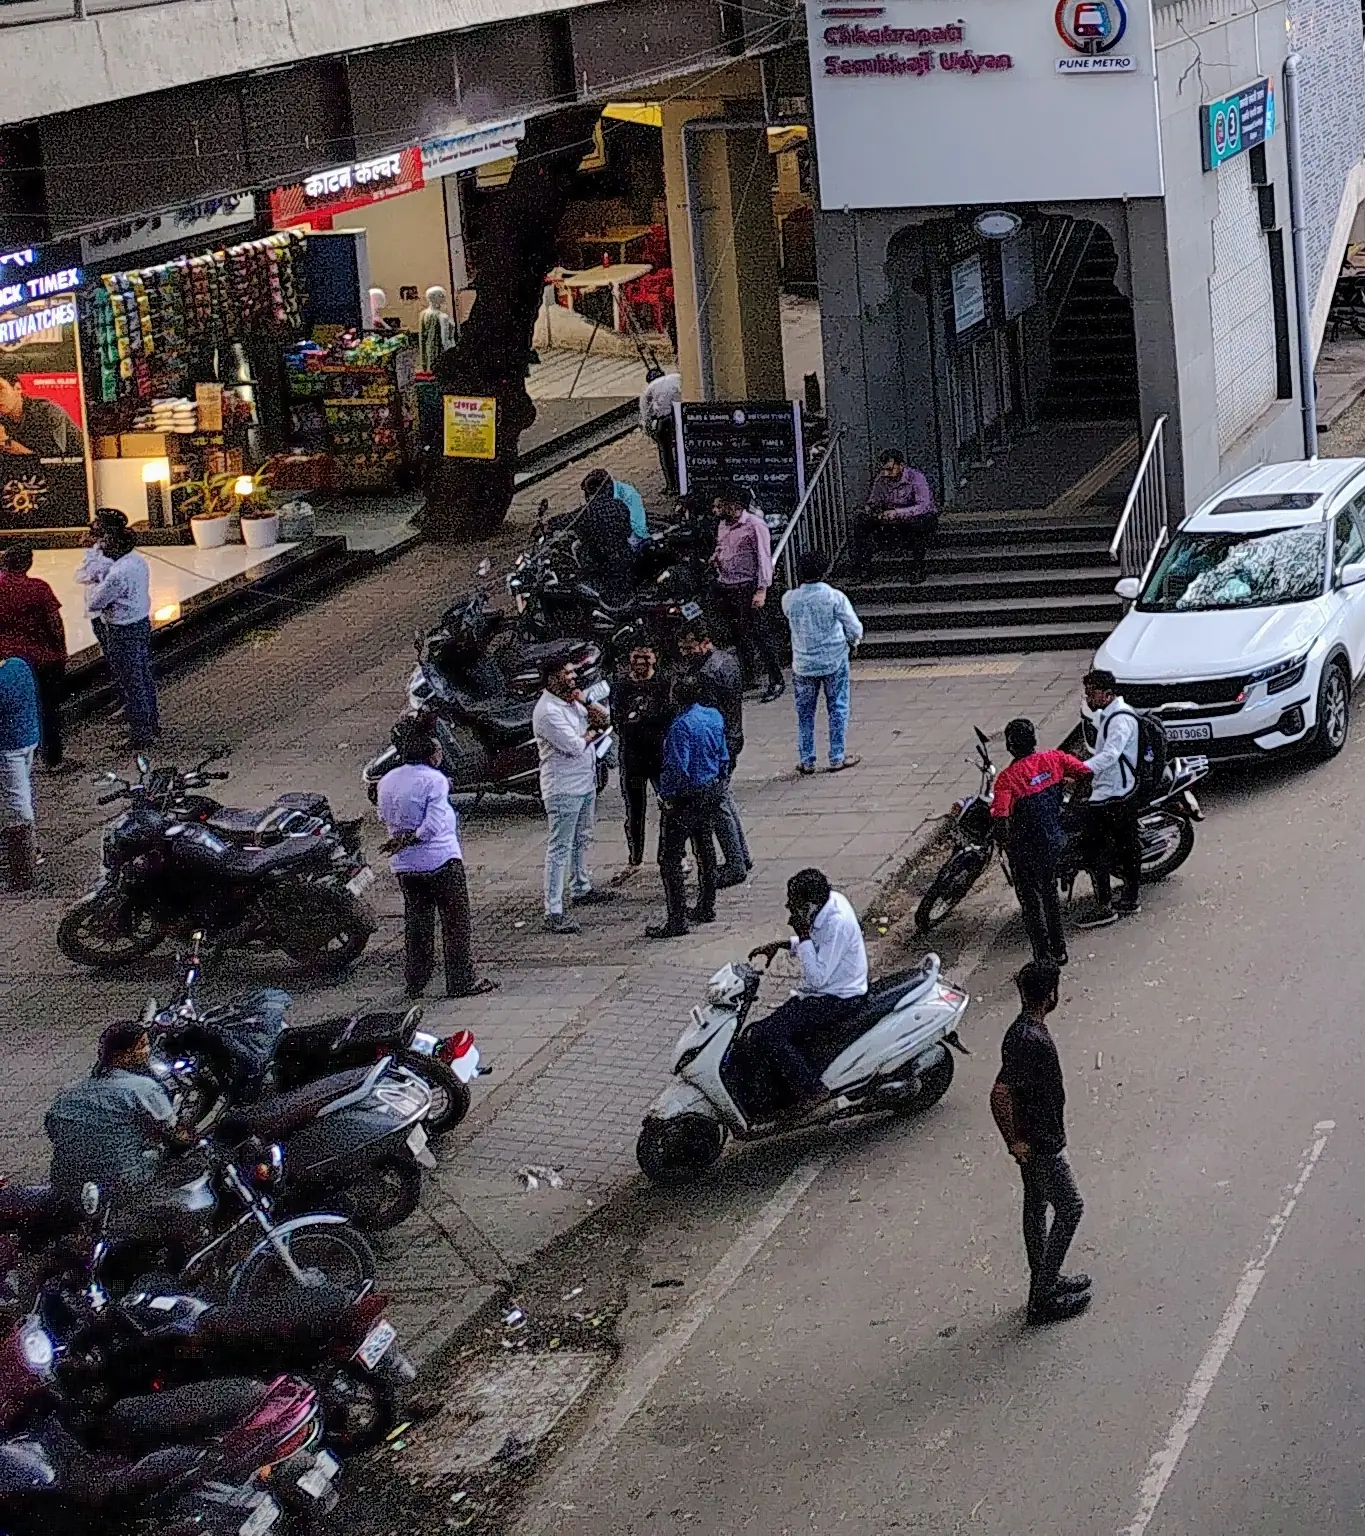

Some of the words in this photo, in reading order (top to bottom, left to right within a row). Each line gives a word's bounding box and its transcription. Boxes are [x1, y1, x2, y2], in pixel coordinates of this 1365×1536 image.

[822, 18, 965, 46] Chhatrapati
[823, 49, 935, 76] Sambhaji
[939, 50, 1015, 74] Udyan
[1058, 59, 1090, 69] PUNE
[1091, 57, 1131, 68] METRO
[1229, 112, 1236, 133] 3
[26, 267, 80, 298] TIMEX
